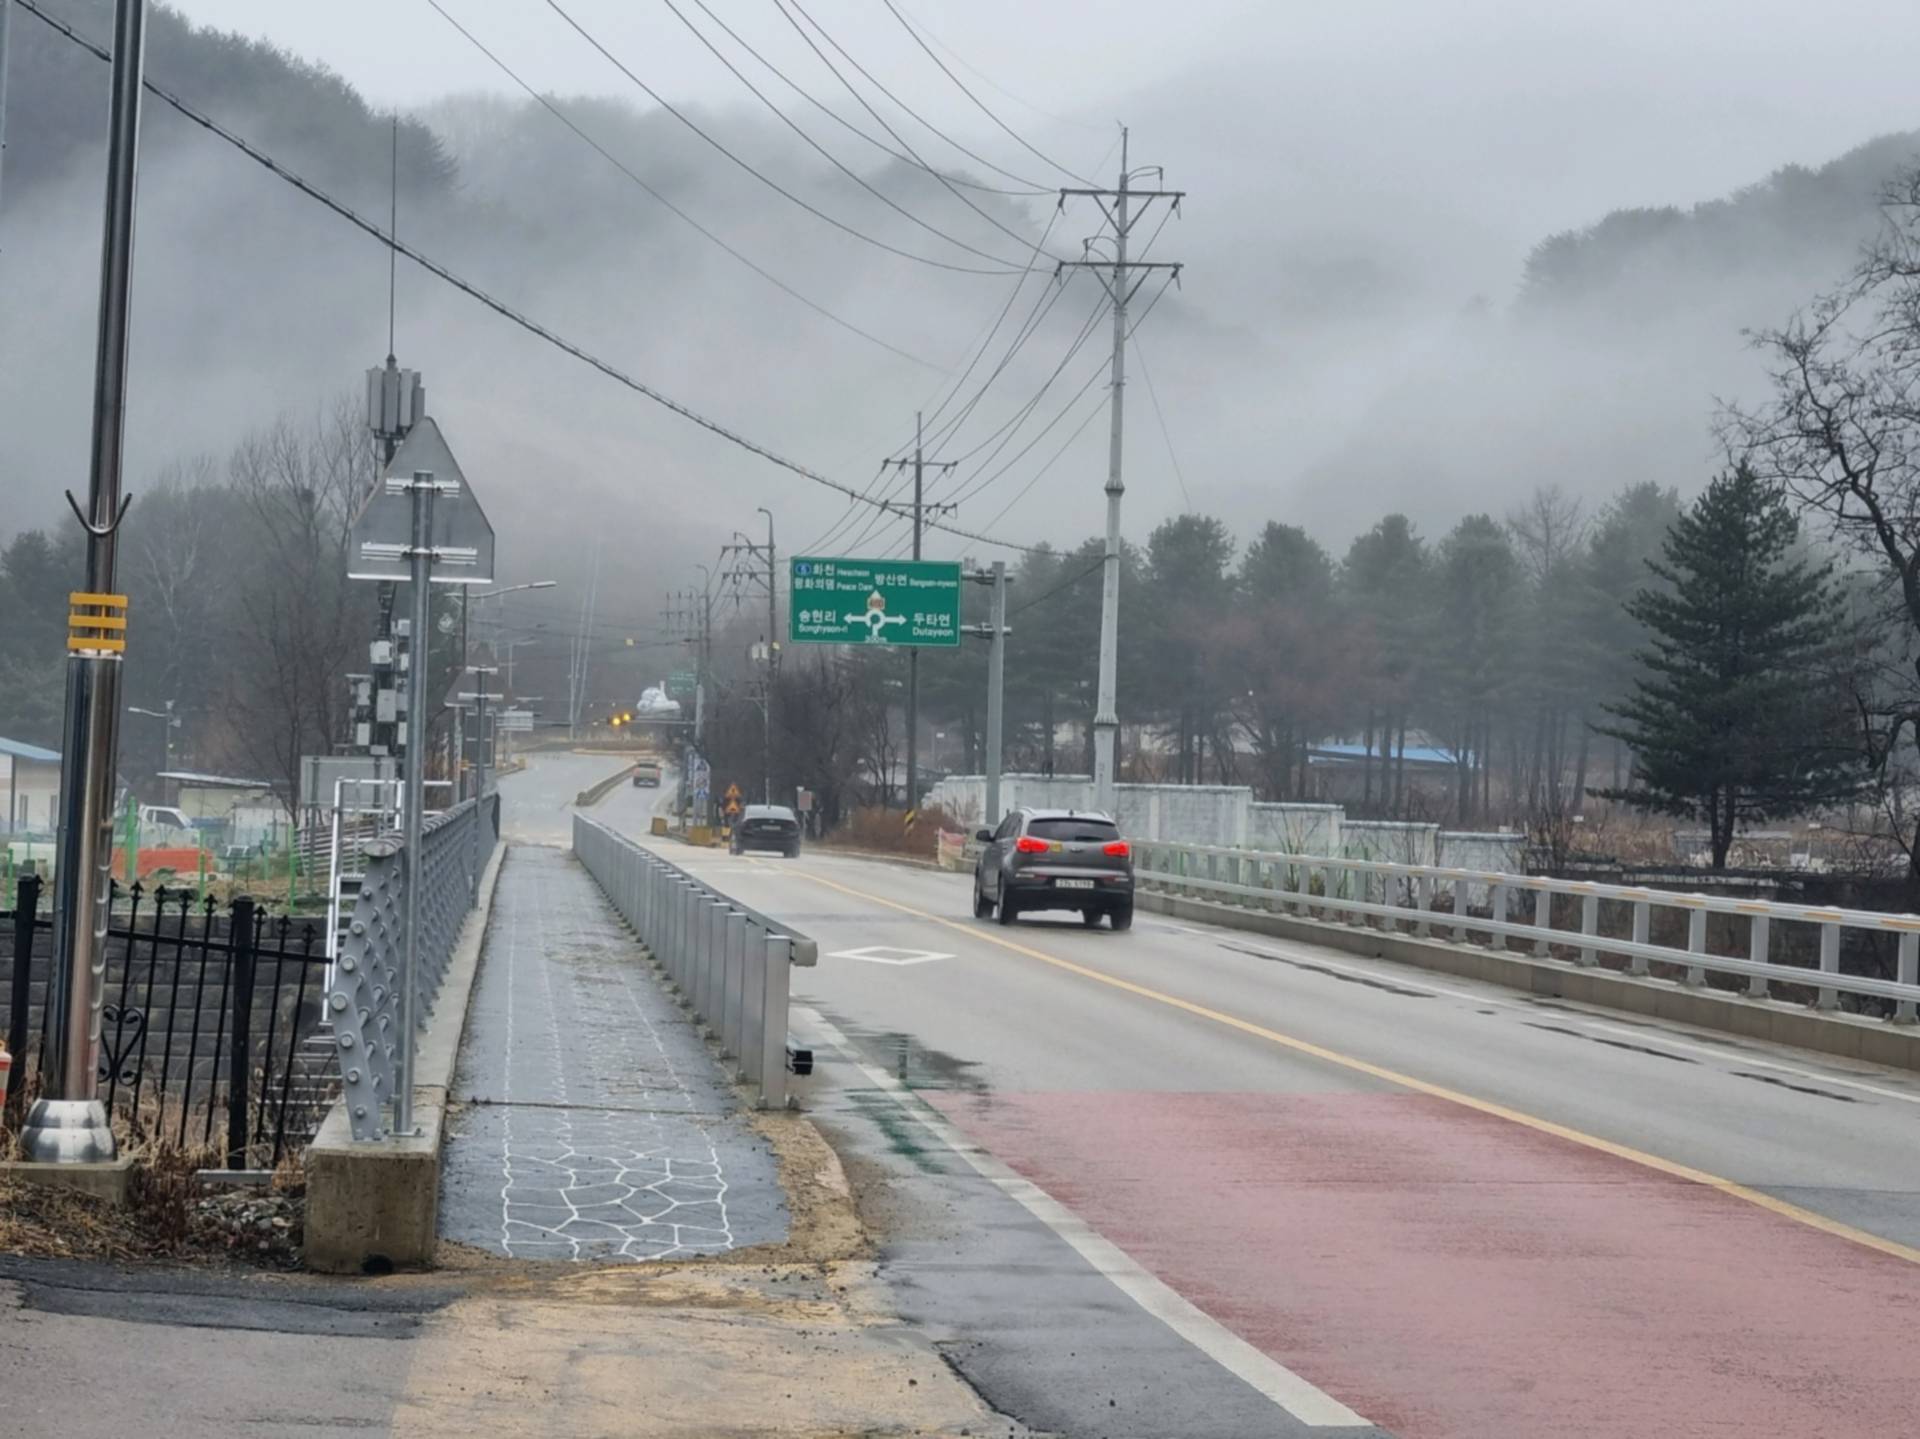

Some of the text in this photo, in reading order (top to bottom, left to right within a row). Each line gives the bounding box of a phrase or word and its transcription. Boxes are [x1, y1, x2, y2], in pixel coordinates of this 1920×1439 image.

[813, 563, 834, 576] 화천
[874, 573, 907, 586] 방산면
[837, 582, 857, 590] Peace
[858, 582, 874, 591] Dam
[799, 609, 836, 623] 송현리
[913, 613, 951, 626] 두타연
[912, 627, 954, 638] Dutayeon
